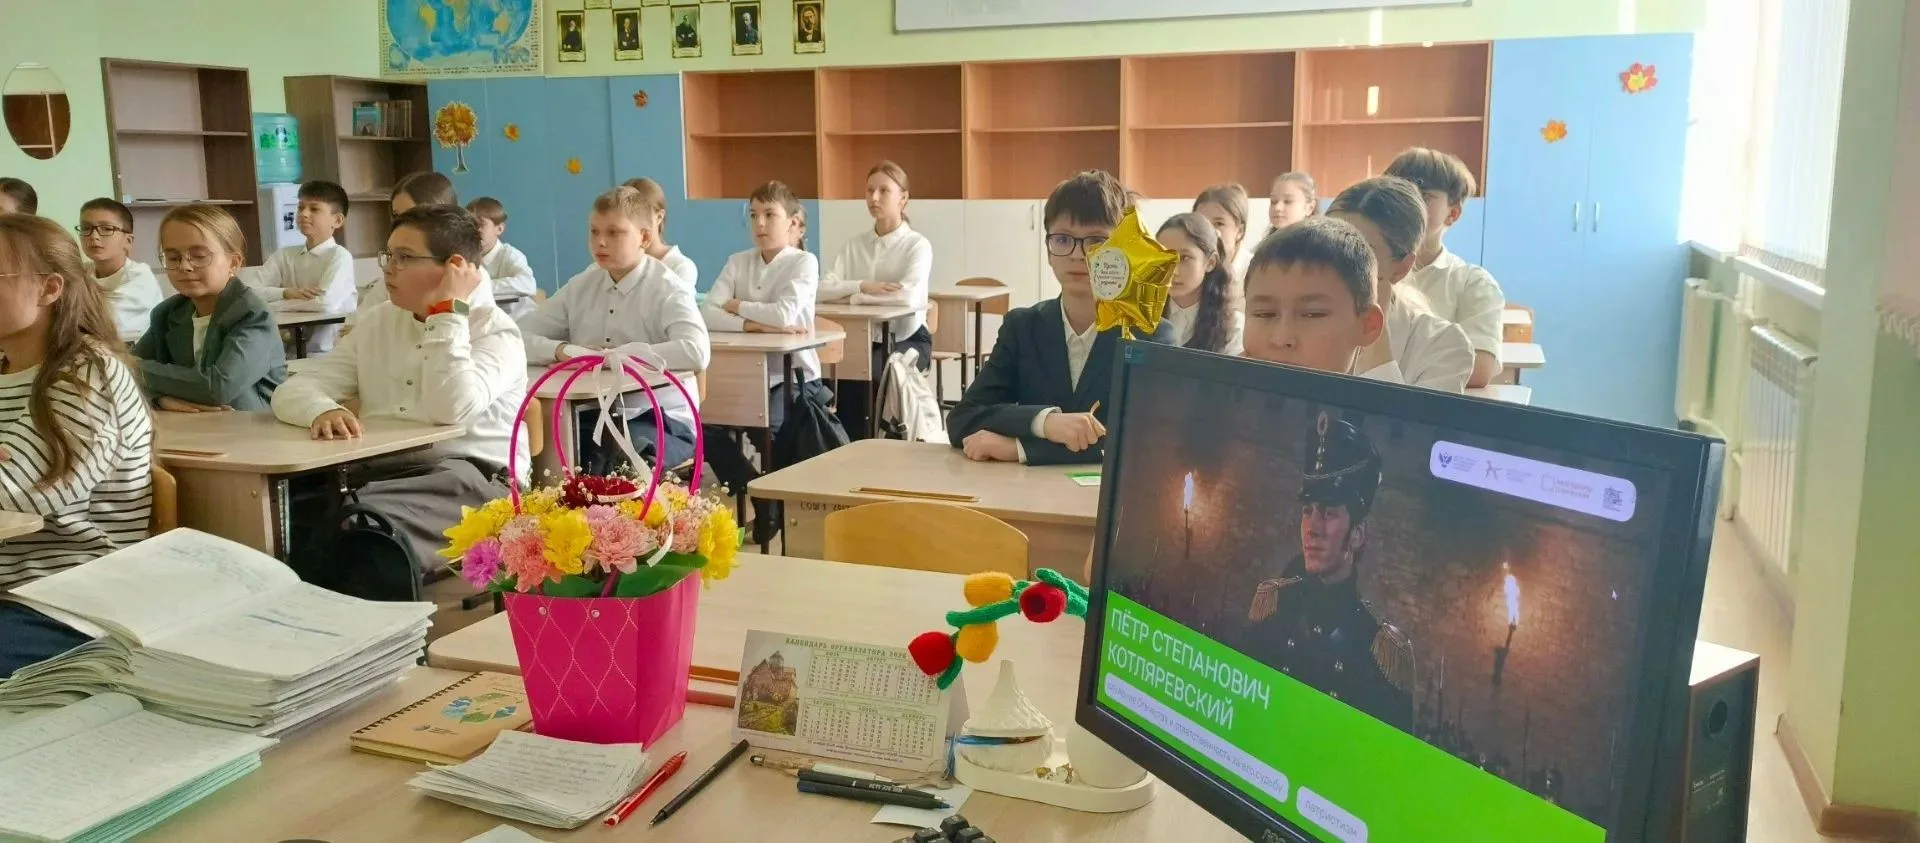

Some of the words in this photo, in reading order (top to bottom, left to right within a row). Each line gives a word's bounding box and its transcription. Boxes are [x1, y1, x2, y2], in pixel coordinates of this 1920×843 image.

[785, 637, 828, 649] КАЛЕНДАРЬ
[830, 643, 886, 657] ОРГАНИЗАТОРА
[1111, 607, 1149, 641] ПЁТР
[1152, 630, 1271, 710] СТЕПАНОВИЧ
[1107, 640, 1235, 730] КОТЛЯРЕВСКИЙ
[1255, 771, 1284, 793] судьбу
[1304, 800, 1358, 836] патриотизм
